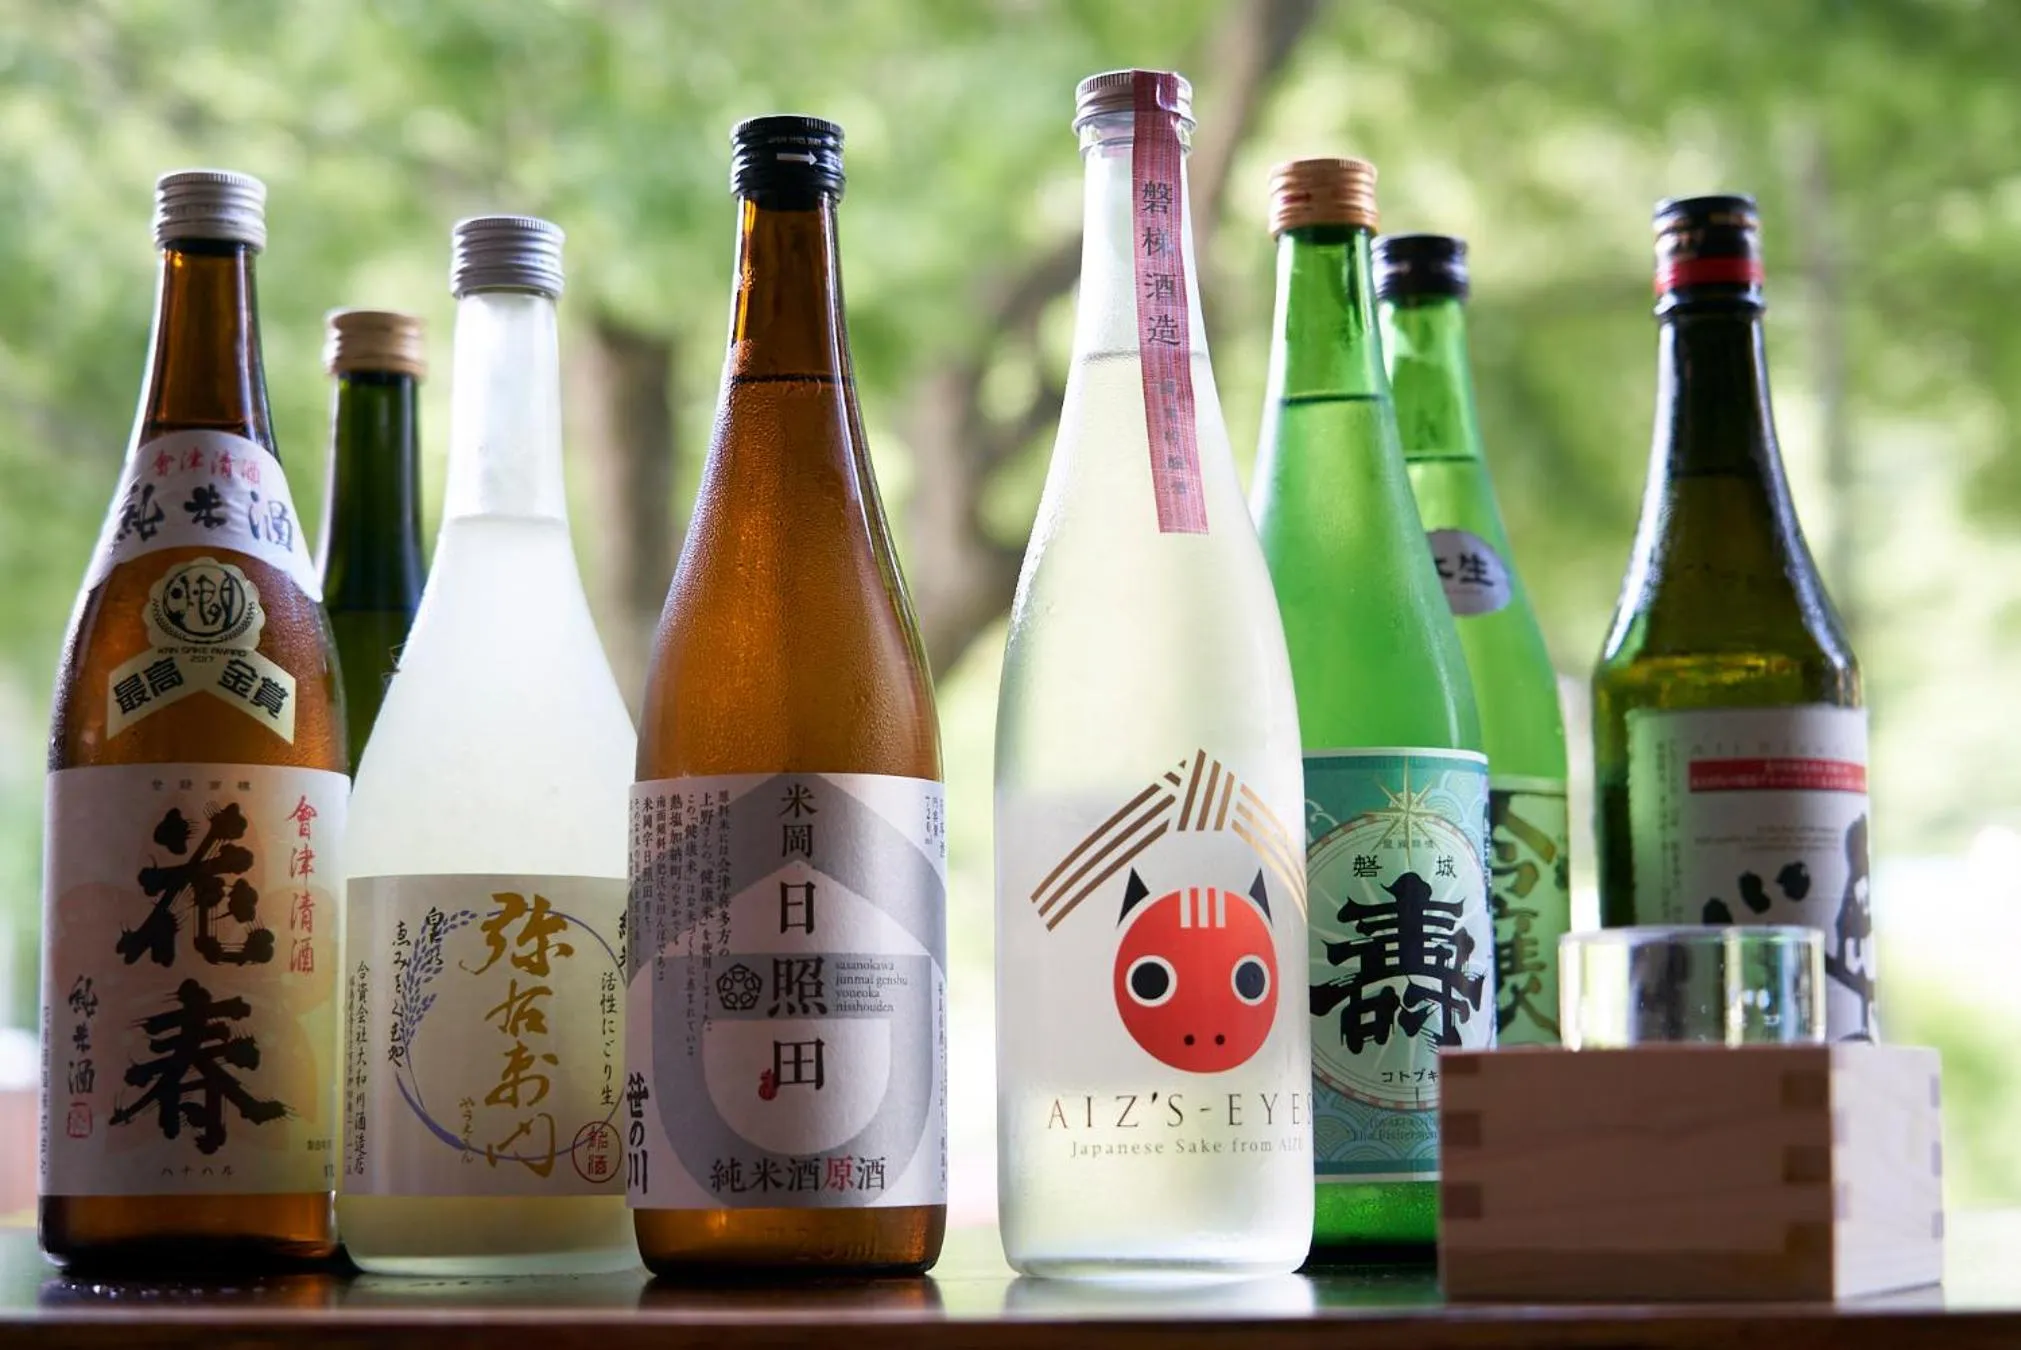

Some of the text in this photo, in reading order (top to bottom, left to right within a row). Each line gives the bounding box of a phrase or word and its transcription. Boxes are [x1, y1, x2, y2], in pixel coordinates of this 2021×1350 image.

[1142, 180, 1180, 345] 磐梯酒造
[113, 657, 289, 719] 最高 金賞
[109, 802, 294, 1155] 花春
[709, 1155, 887, 1193] 純米酒原酒
[1070, 1141, 1165, 1158] Japanese
[1175, 1138, 1222, 1154] Sake
[1232, 1138, 1272, 1153] from
